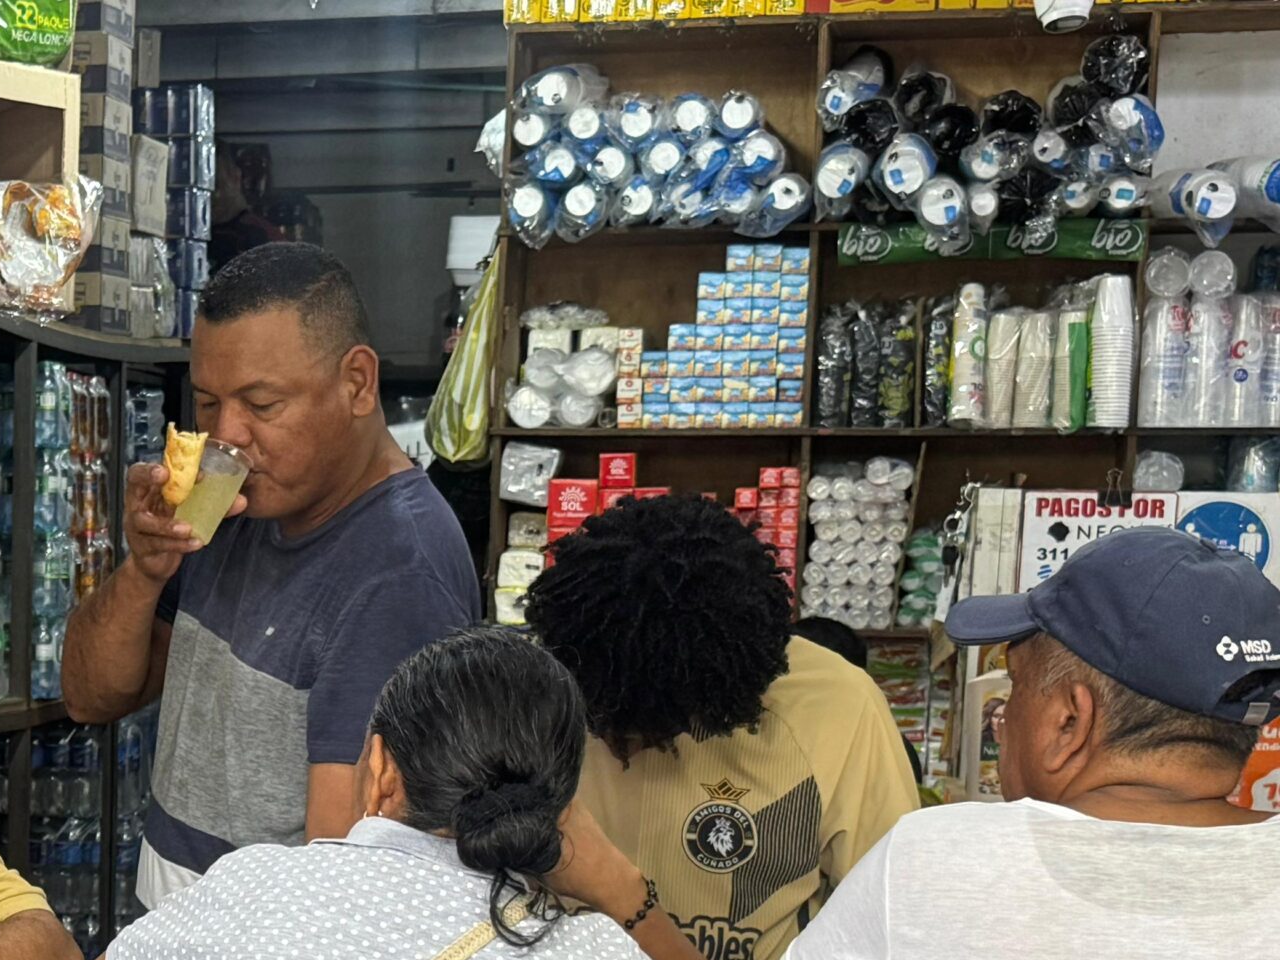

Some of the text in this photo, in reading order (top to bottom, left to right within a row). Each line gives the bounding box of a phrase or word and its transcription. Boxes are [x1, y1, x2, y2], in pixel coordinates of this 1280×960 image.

[11, 29, 37, 43] MEGA
[561, 502, 583, 512] SOL
[1240, 640, 1272, 654] MSD
[694, 805, 750, 829] AMIGOS DEL
